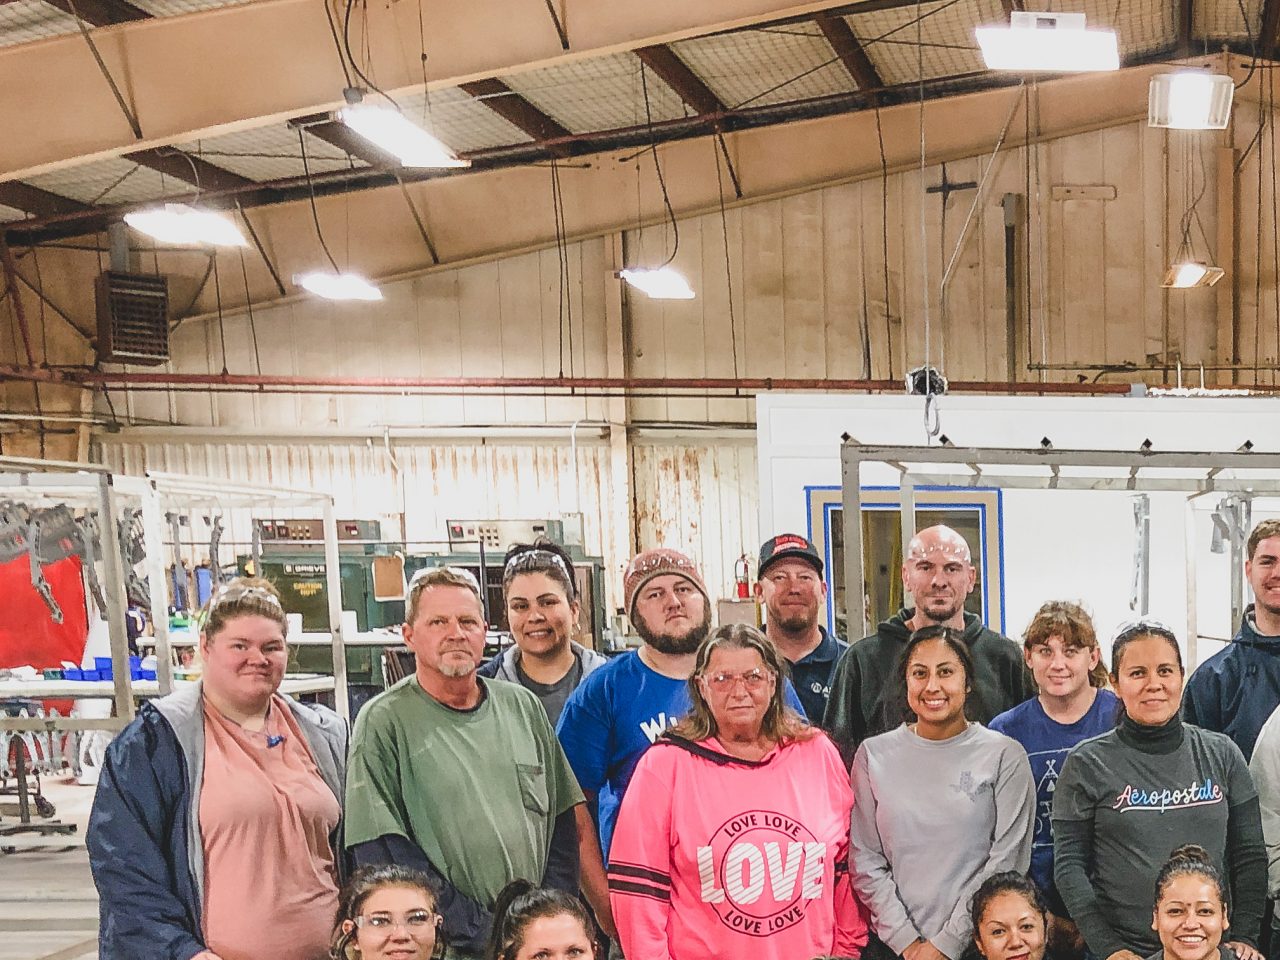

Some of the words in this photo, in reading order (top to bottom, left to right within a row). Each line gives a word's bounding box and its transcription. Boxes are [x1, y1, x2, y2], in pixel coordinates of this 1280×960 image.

[724, 815, 757, 838] LOVE
[764, 815, 801, 837] LOVE
[697, 842, 826, 905] LOVE
[724, 910, 762, 933] LOVE
[768, 906, 803, 931] LOVE
